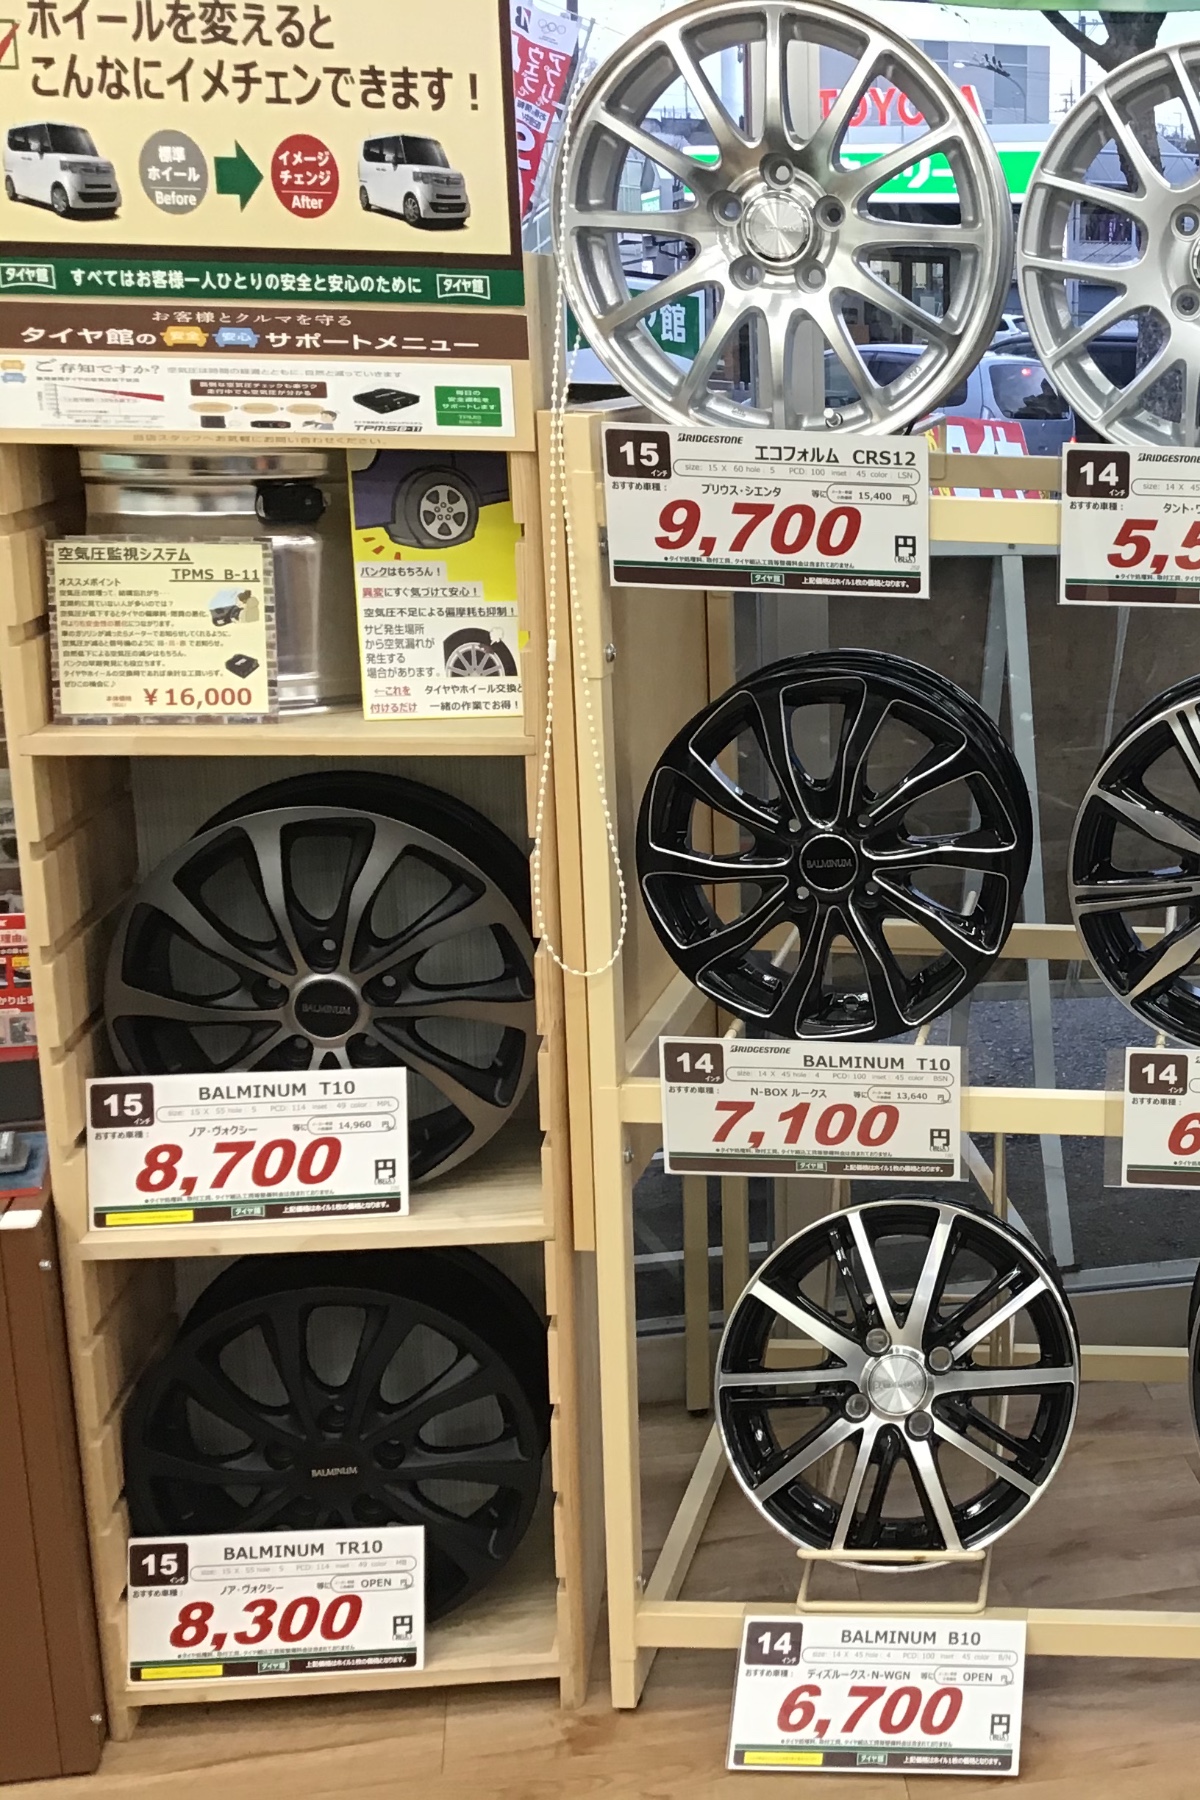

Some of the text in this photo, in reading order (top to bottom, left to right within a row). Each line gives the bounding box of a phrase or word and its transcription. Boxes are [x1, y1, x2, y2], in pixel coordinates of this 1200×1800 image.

[28, 1, 336, 50] ホイールを変えると
[32, 55, 479, 111] こんなにイメチェンできます！
[158, 144, 186, 162] 標準
[278, 149, 330, 166] イメージ
[147, 165, 200, 183] ホイール
[279, 168, 331, 185] チェンジ
[155, 191, 197, 207] Before
[292, 195, 324, 210] After
[6, 267, 50, 283] タイヤ館
[70, 268, 422, 294] すべてはお客様一人ひとりの安全と安心のために
[443, 278, 485, 294] タイヤ館
[152, 310, 352, 327] お客様とクルマを守る
[21, 327, 156, 347] タイヤ館の
[265, 331, 479, 351] サポートメニュー
[678, 433, 743, 444] BRIDGESTONE
[619, 441, 659, 467] 15
[755, 446, 916, 466] エコフォルム CRS12
[650, 469, 668, 477] インチ
[1080, 461, 1119, 486] 14
[859, 492, 891, 501] 15,400
[1109, 488, 1126, 496] インチ
[655, 499, 916, 557] 9,700 円
[58, 547, 191, 561] 空気圧監視システム
[173, 569, 259, 580] TPMS B-11
[361, 567, 440, 577] パンクはもちろん！
[59, 578, 120, 586] オススメポイント
[364, 624, 424, 635] サビ発生場所
[365, 638, 435, 649] から空気漏れが
[366, 654, 405, 664] 発生する
[367, 668, 440, 678] 場合があります。
[370, 702, 417, 713] 付けるだけ
[806, 858, 853, 868] BALMINUM
[730, 1044, 791, 1054] BRIDGESTONE
[676, 1052, 714, 1074] 14
[803, 1055, 950, 1071] BALMINUM T10
[1141, 1063, 1178, 1085] 14
[199, 1081, 355, 1100] BALMINUM T10
[750, 1088, 787, 1098] N-BOX
[897, 1092, 928, 1100] 13,640
[104, 1093, 143, 1116] 15
[339, 1120, 371, 1129] 14,960
[712, 1100, 950, 1149] 7,100 円
[136, 1136, 396, 1196] 8,700 円
[224, 1540, 382, 1560] BALMINUM TR10
[141, 1554, 178, 1576] 15
[361, 1578, 392, 1588] OPEN
[169, 1594, 413, 1650] 8,300 円
[757, 1632, 792, 1655] 14
[842, 1630, 980, 1645] BALMINUM B10
[963, 1672, 993, 1682] OPEN
[777, 1684, 1010, 1738] 6,700 円
